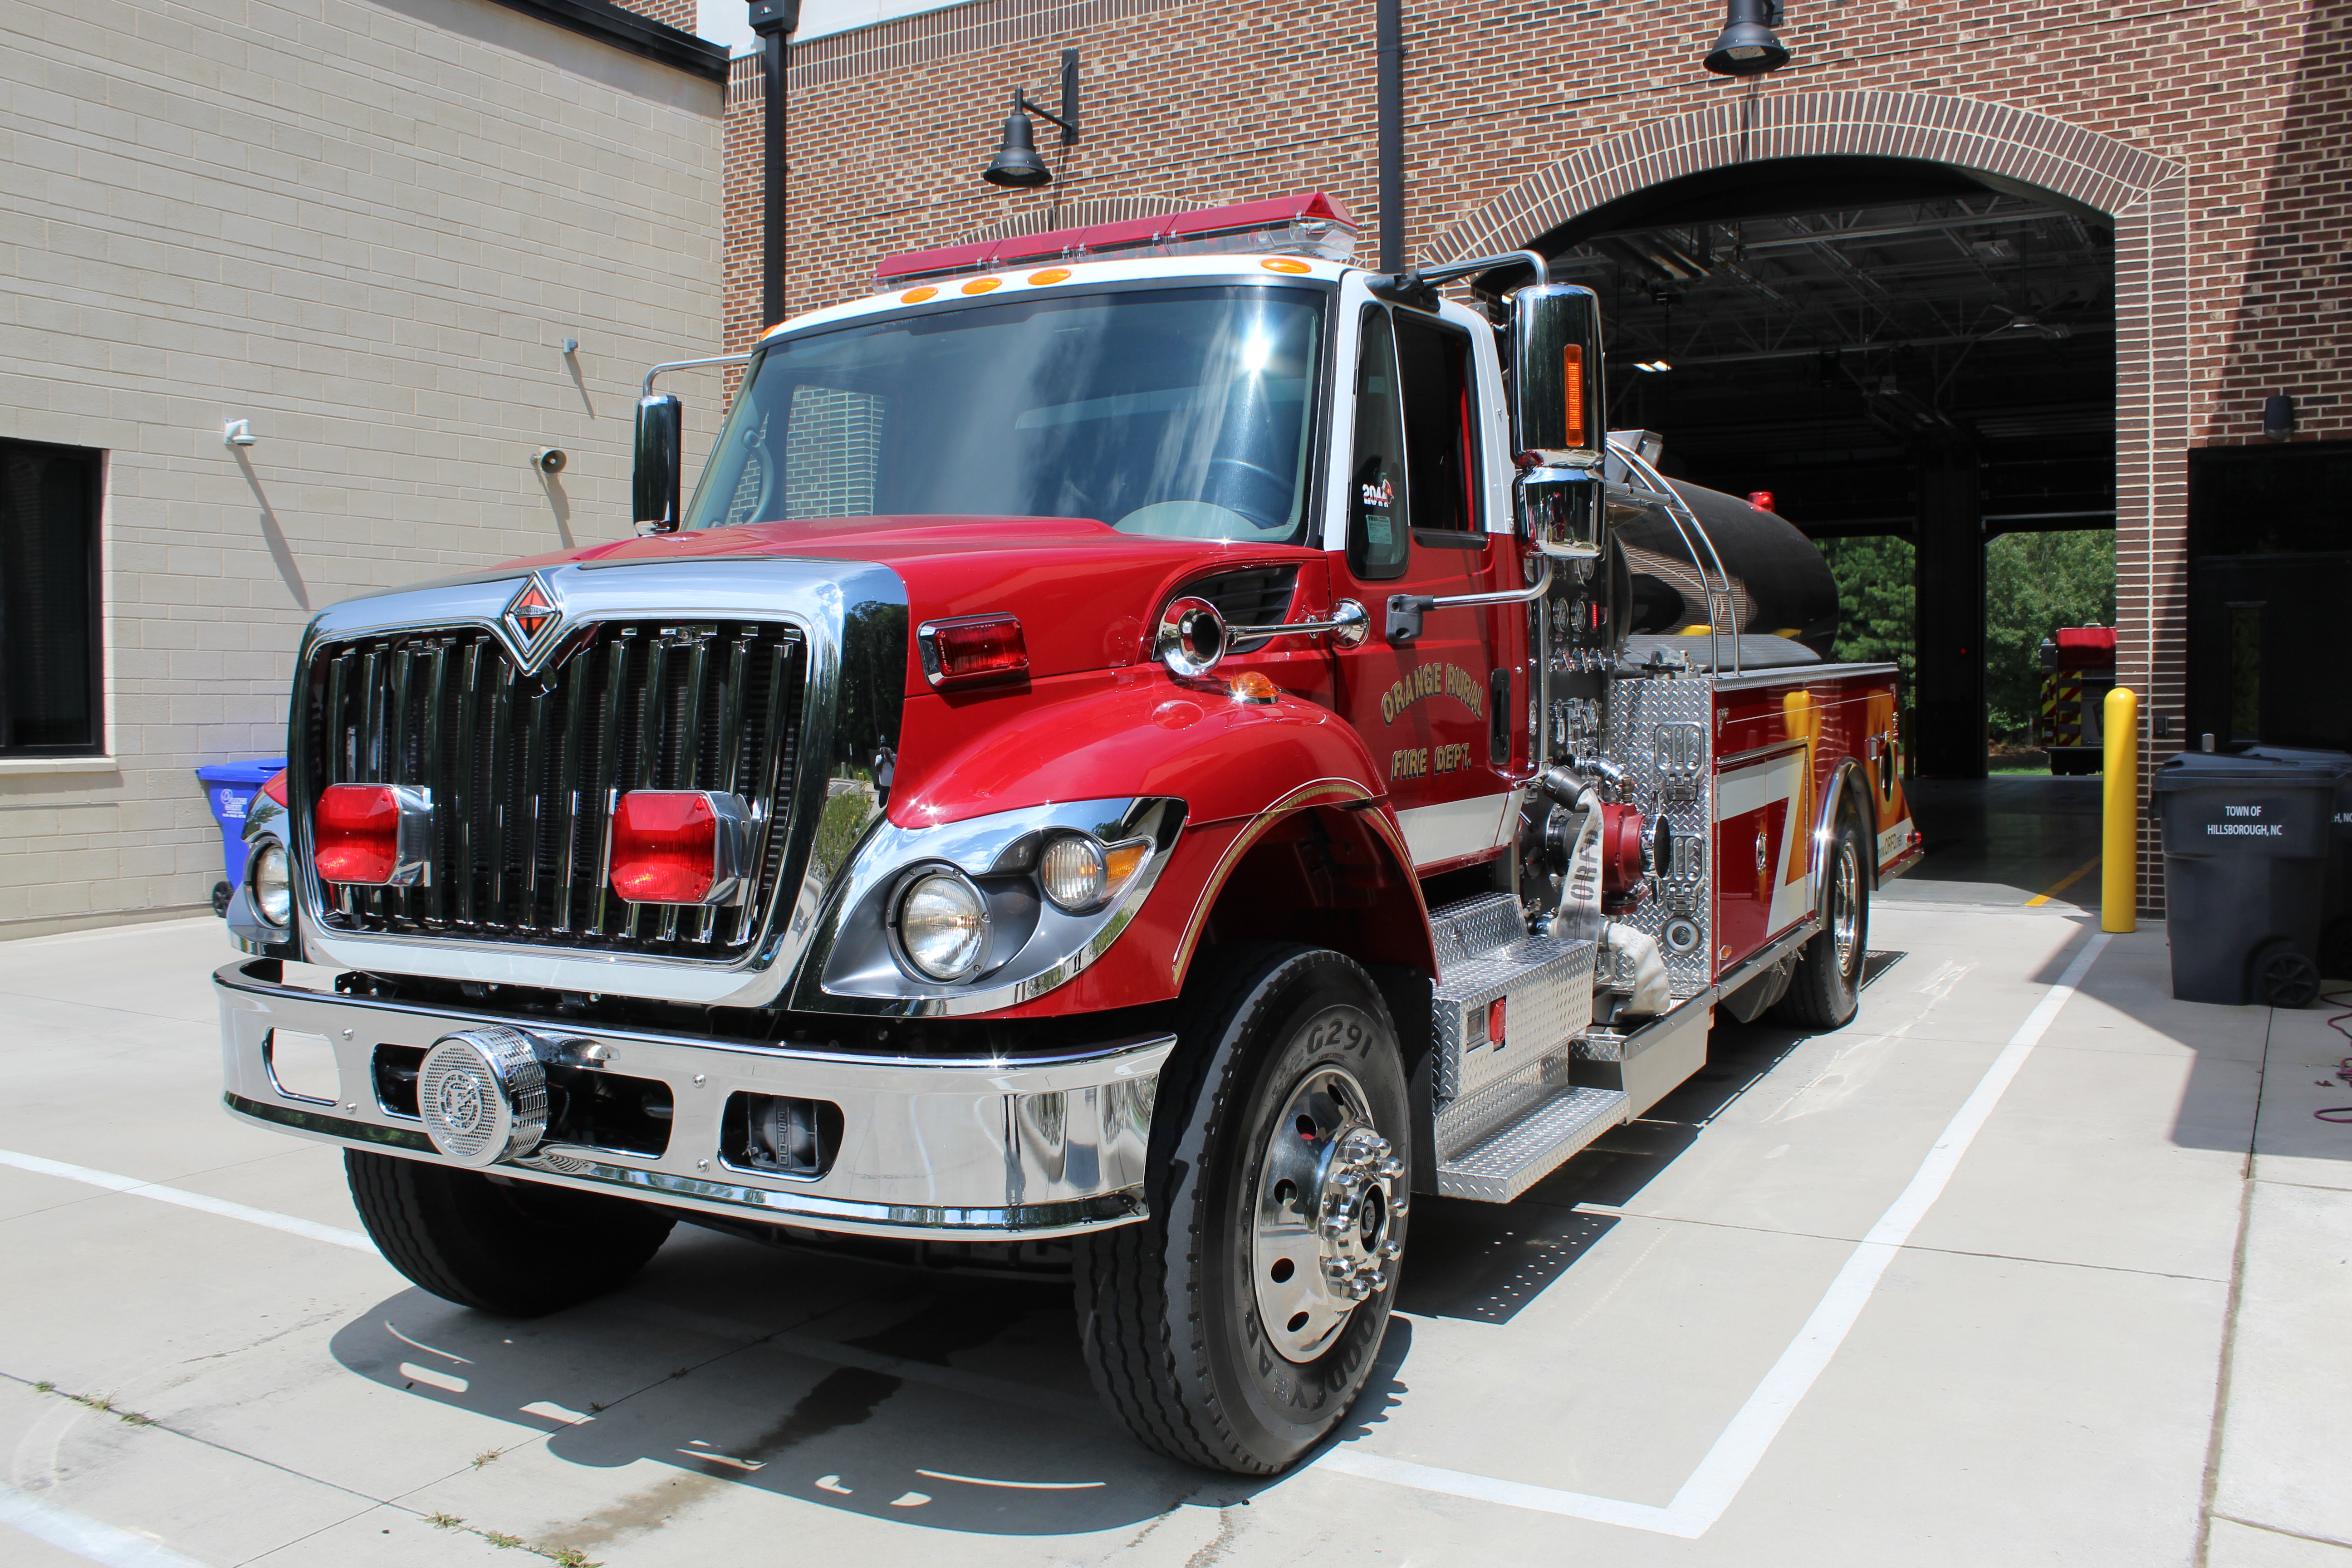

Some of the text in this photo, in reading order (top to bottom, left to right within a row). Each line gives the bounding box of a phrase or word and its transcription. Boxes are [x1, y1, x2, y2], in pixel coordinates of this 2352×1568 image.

[1381, 663, 1484, 727] ORANGE RURAL
[1391, 743, 1472, 781] FIRE DEPT.
[2208, 824, 2282, 836] HILLSBOROUGH, NC
[2225, 806, 2261, 816] TOWN OF
[1307, 1019, 1373, 1060] G291
[778, 1111, 788, 1165] ES100
